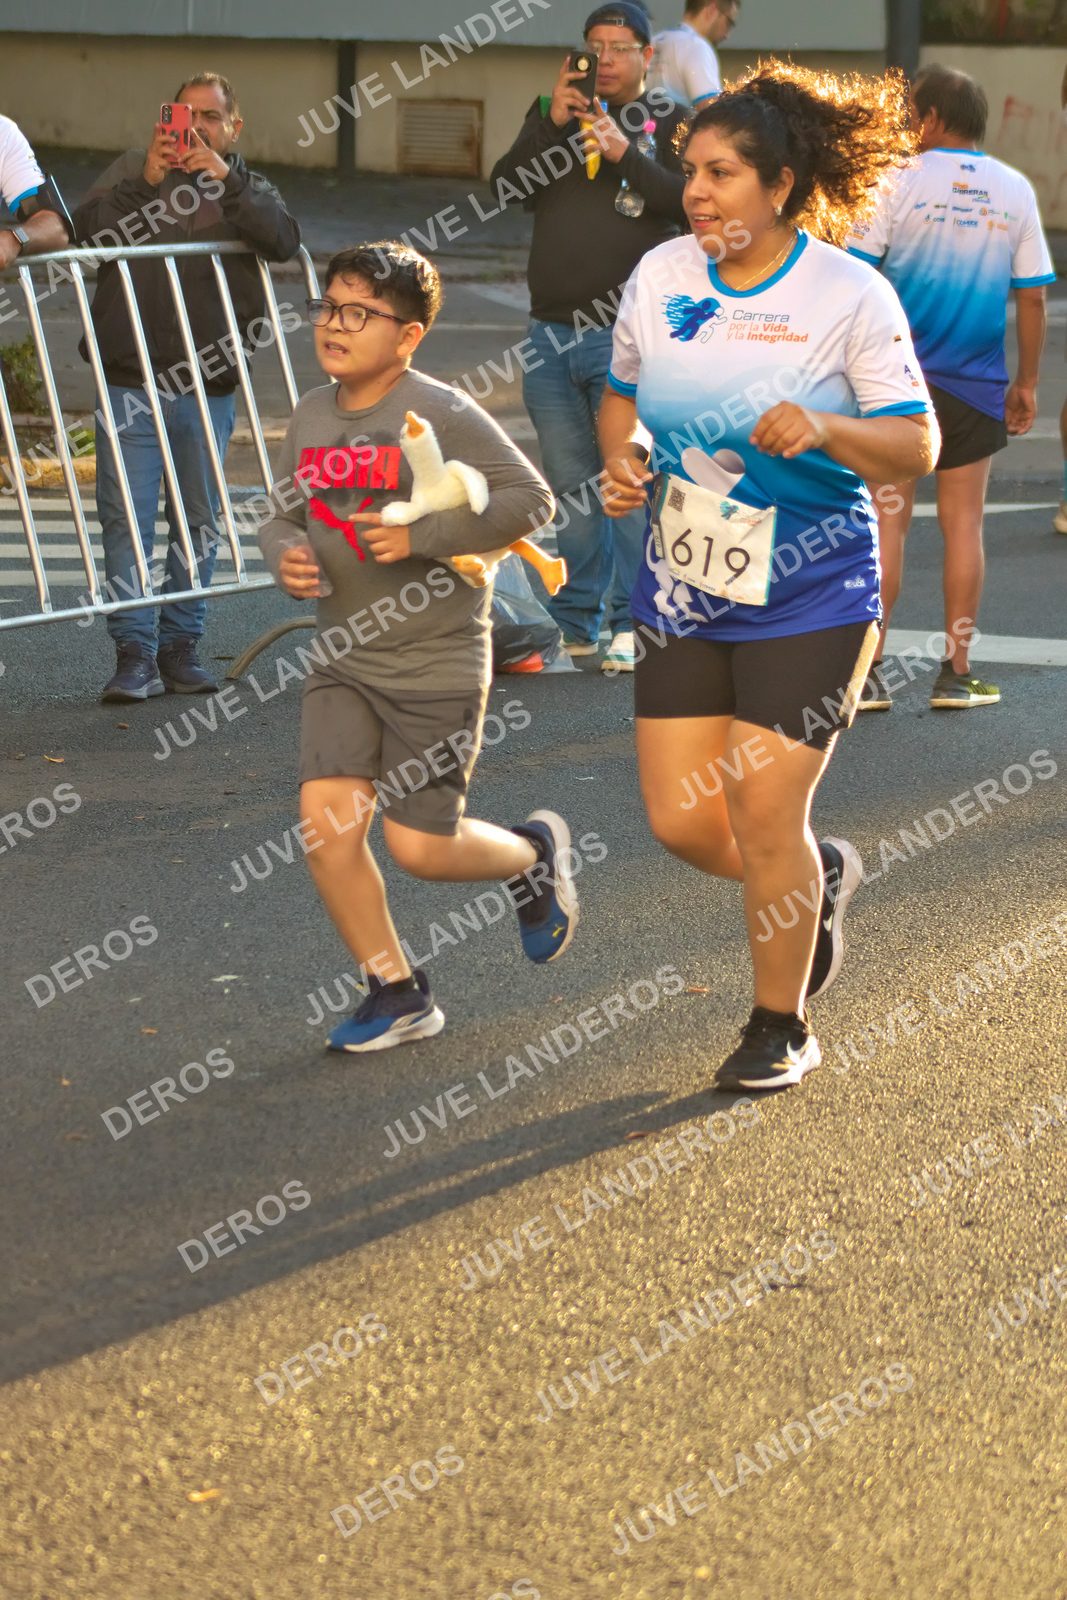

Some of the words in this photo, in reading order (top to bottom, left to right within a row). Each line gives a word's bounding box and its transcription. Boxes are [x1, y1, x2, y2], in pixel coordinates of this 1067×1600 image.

[732, 309, 790, 323] Carrera
[729, 323, 749, 332] por
[750, 322, 759, 332] la
[762, 323, 788, 333] Vida
[726, 333, 733, 341] y
[734, 331, 744, 340] la
[747, 332, 809, 344] Integridad
[671, 528, 750, 586] 619
